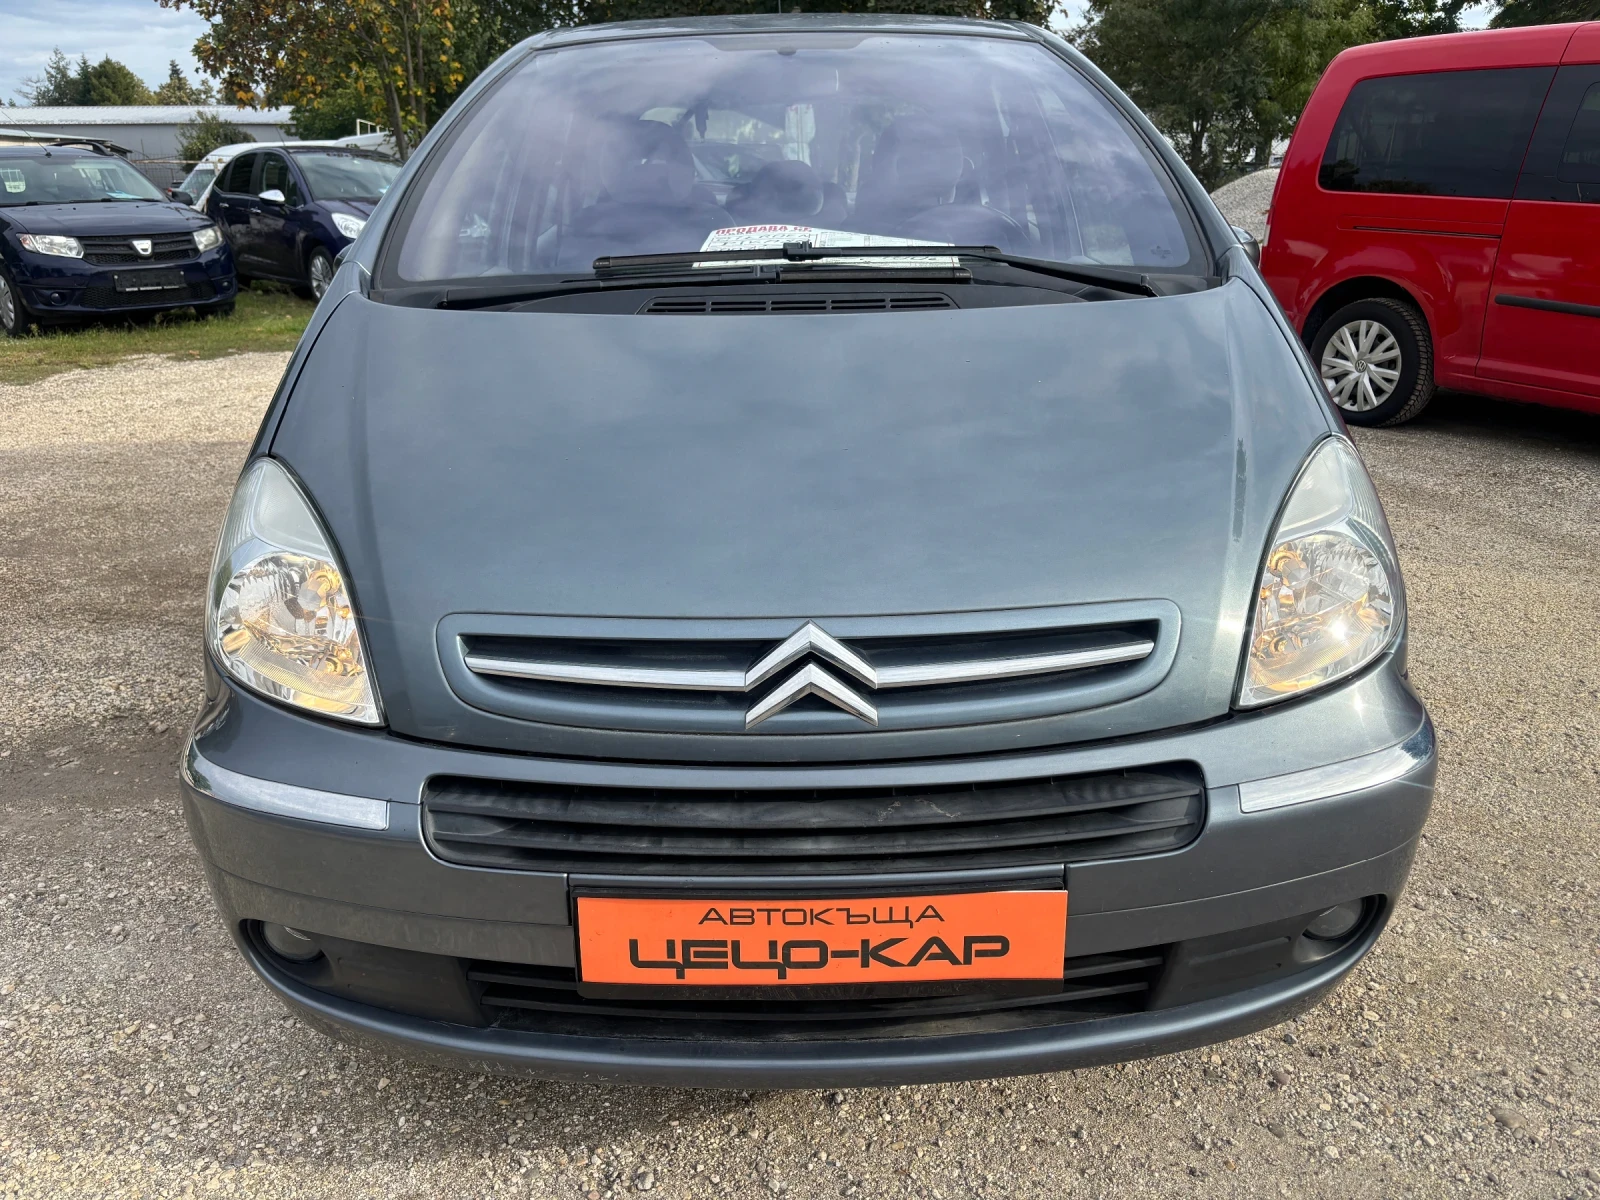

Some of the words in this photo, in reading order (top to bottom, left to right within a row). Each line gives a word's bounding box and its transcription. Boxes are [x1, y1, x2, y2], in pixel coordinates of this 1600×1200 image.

[715, 225, 789, 236] ПРОДАВА
[698, 904, 945, 929] АВТОКЪЩА
[628, 935, 1011, 980] ЦЕЦО-КАР
